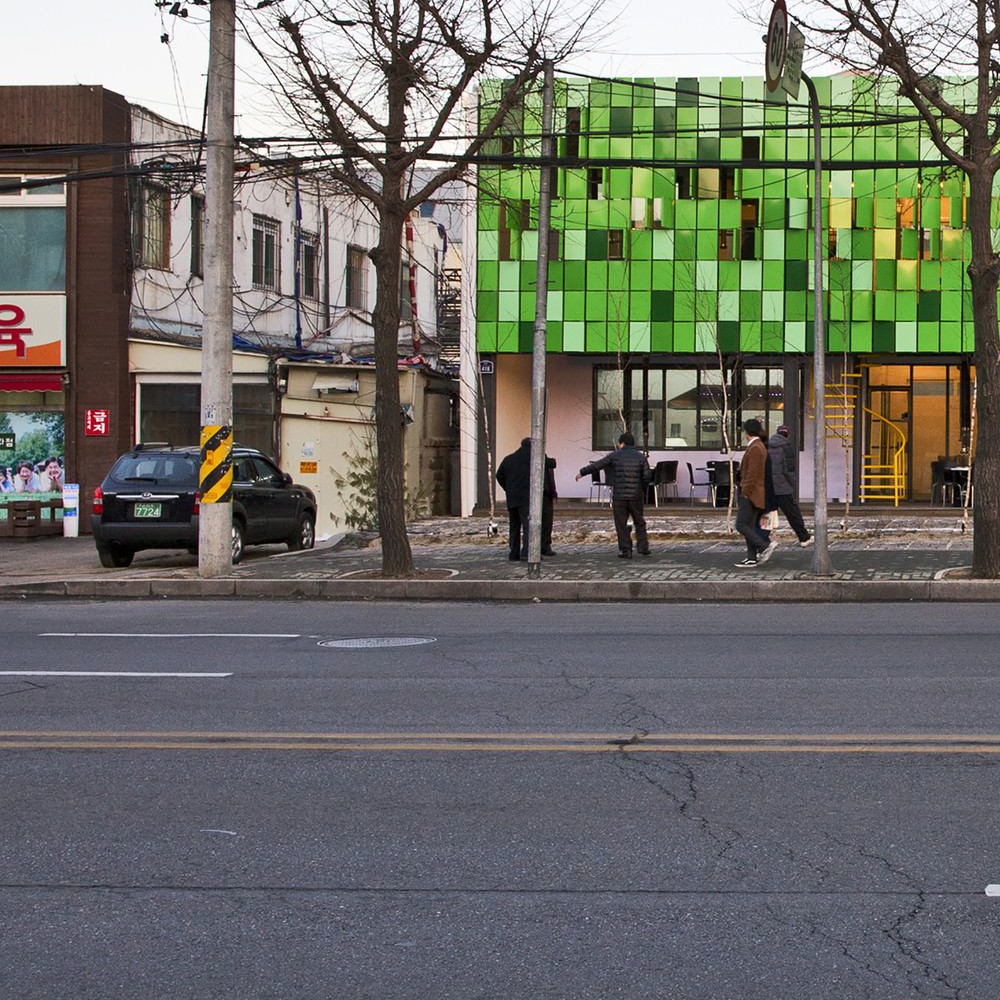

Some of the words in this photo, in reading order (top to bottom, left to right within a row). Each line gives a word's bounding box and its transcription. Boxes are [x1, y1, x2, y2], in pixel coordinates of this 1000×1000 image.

[770, 22, 784, 67] 60
[92, 411, 107, 434] 금지
[136, 507, 159, 517] 7724
